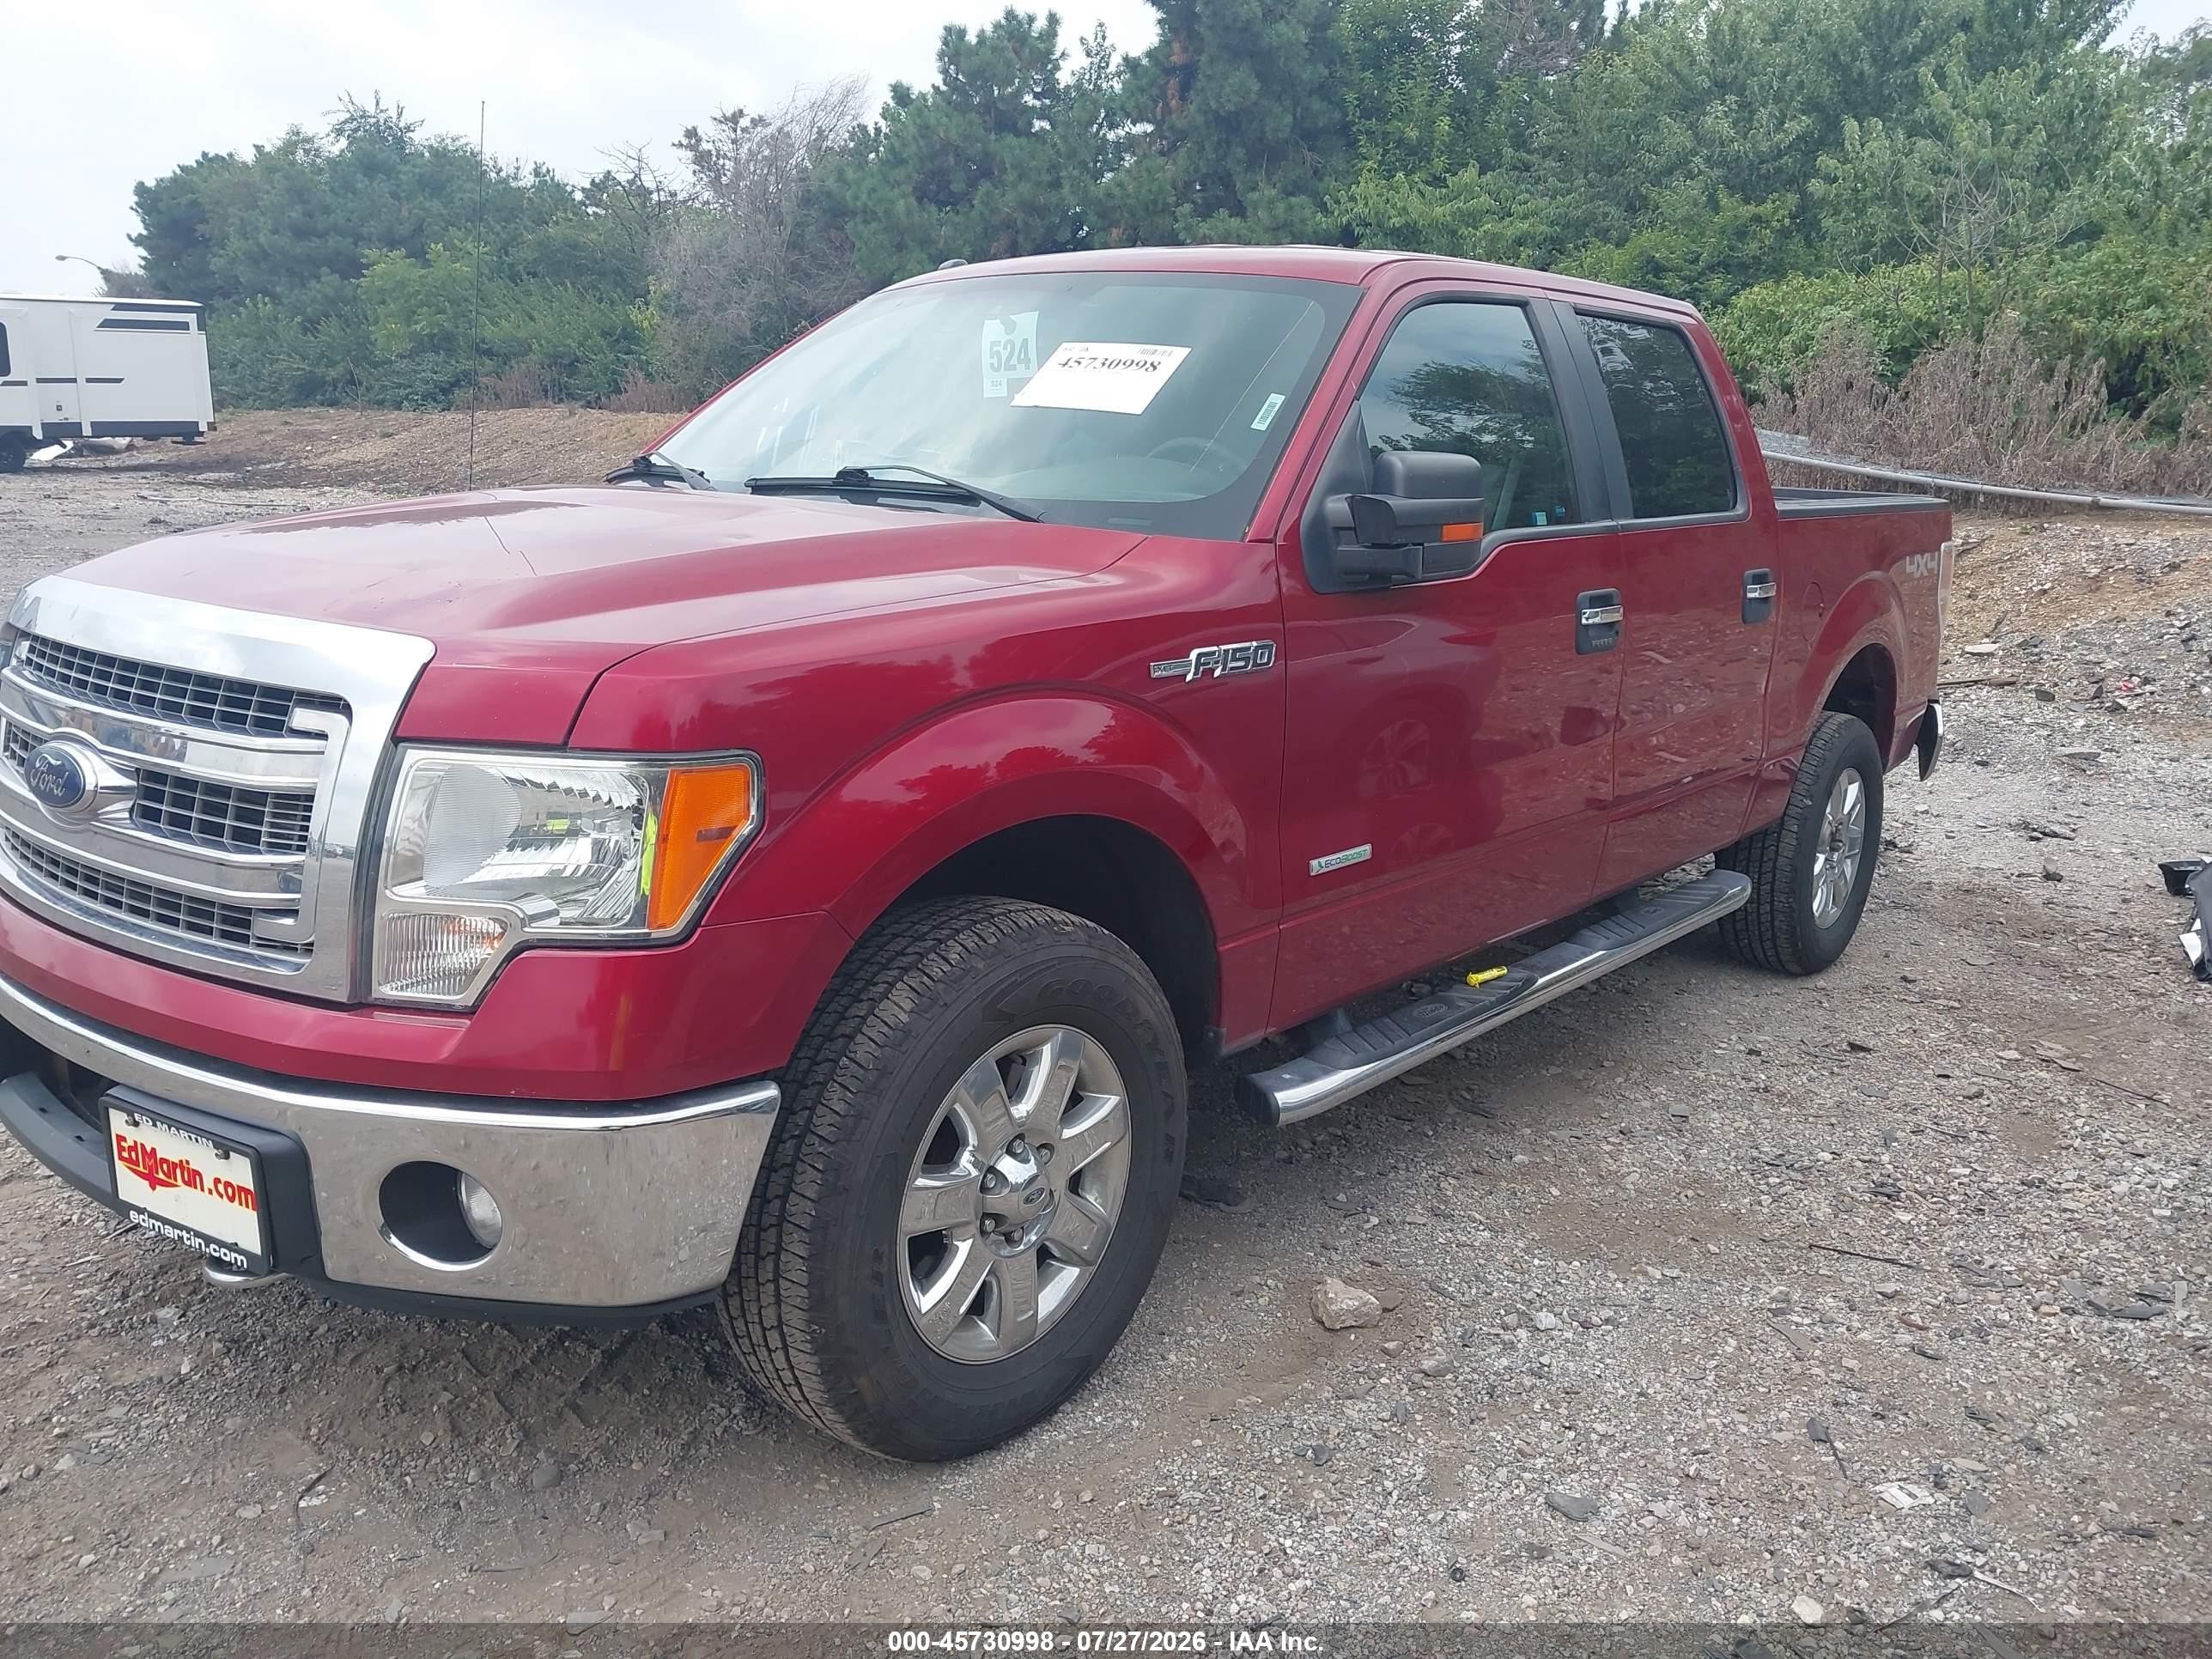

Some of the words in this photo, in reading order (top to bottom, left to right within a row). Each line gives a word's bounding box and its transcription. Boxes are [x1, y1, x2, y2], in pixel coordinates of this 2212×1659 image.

[989, 337, 1031, 373] 524
[1058, 357, 1162, 373] 45730998
[30, 753, 69, 797] Ford
[1324, 848, 1368, 868] ECOBOOST
[134, 1114, 153, 1127] ED
[156, 1121, 214, 1149] MARTIN
[129, 1209, 247, 1269] edmartin.com
